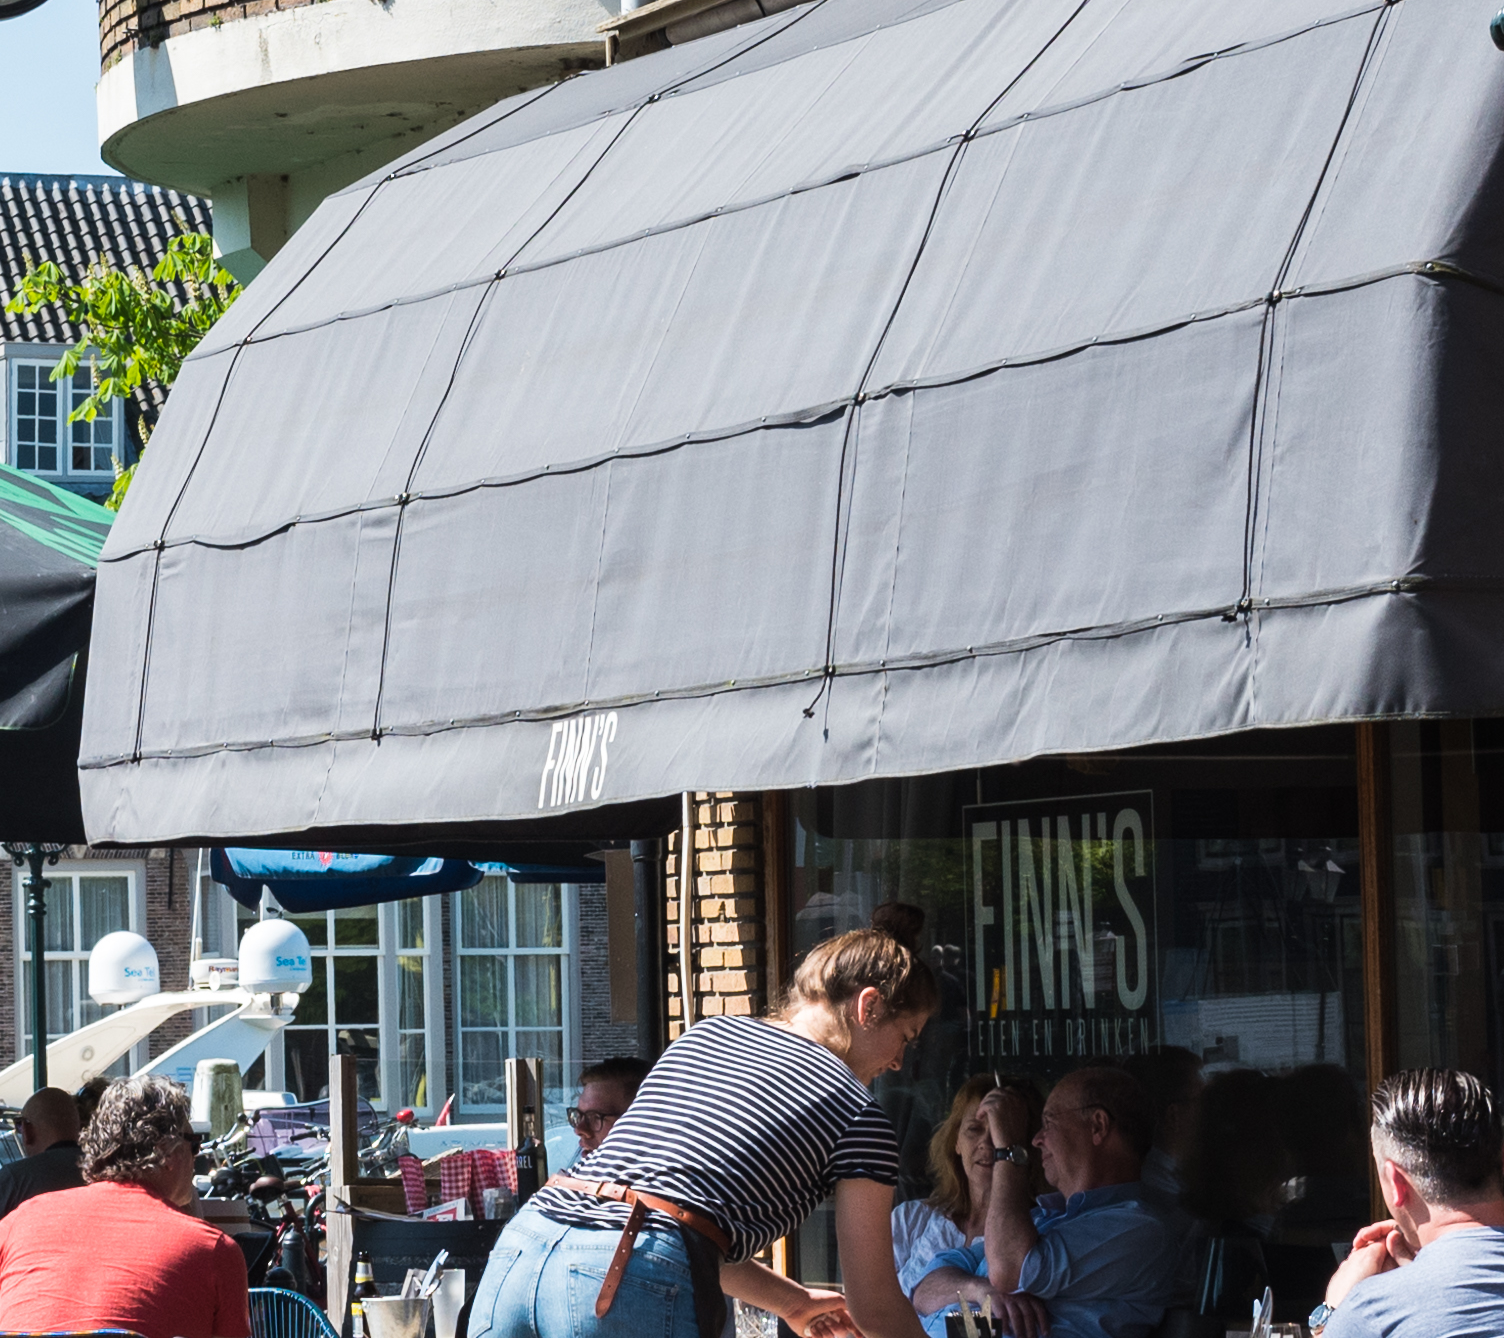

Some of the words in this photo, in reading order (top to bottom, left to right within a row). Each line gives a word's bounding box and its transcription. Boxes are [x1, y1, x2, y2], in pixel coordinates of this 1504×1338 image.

[538, 711, 618, 809] FINN'S
[972, 808, 1148, 1011] FINN'S
[124, 967, 142, 978] Sea
[276, 956, 295, 967] Sea
[978, 1019, 1020, 1057] ETEN
[1032, 1019, 1053, 1057] EN
[1066, 1017, 1149, 1056] DRINKEN
